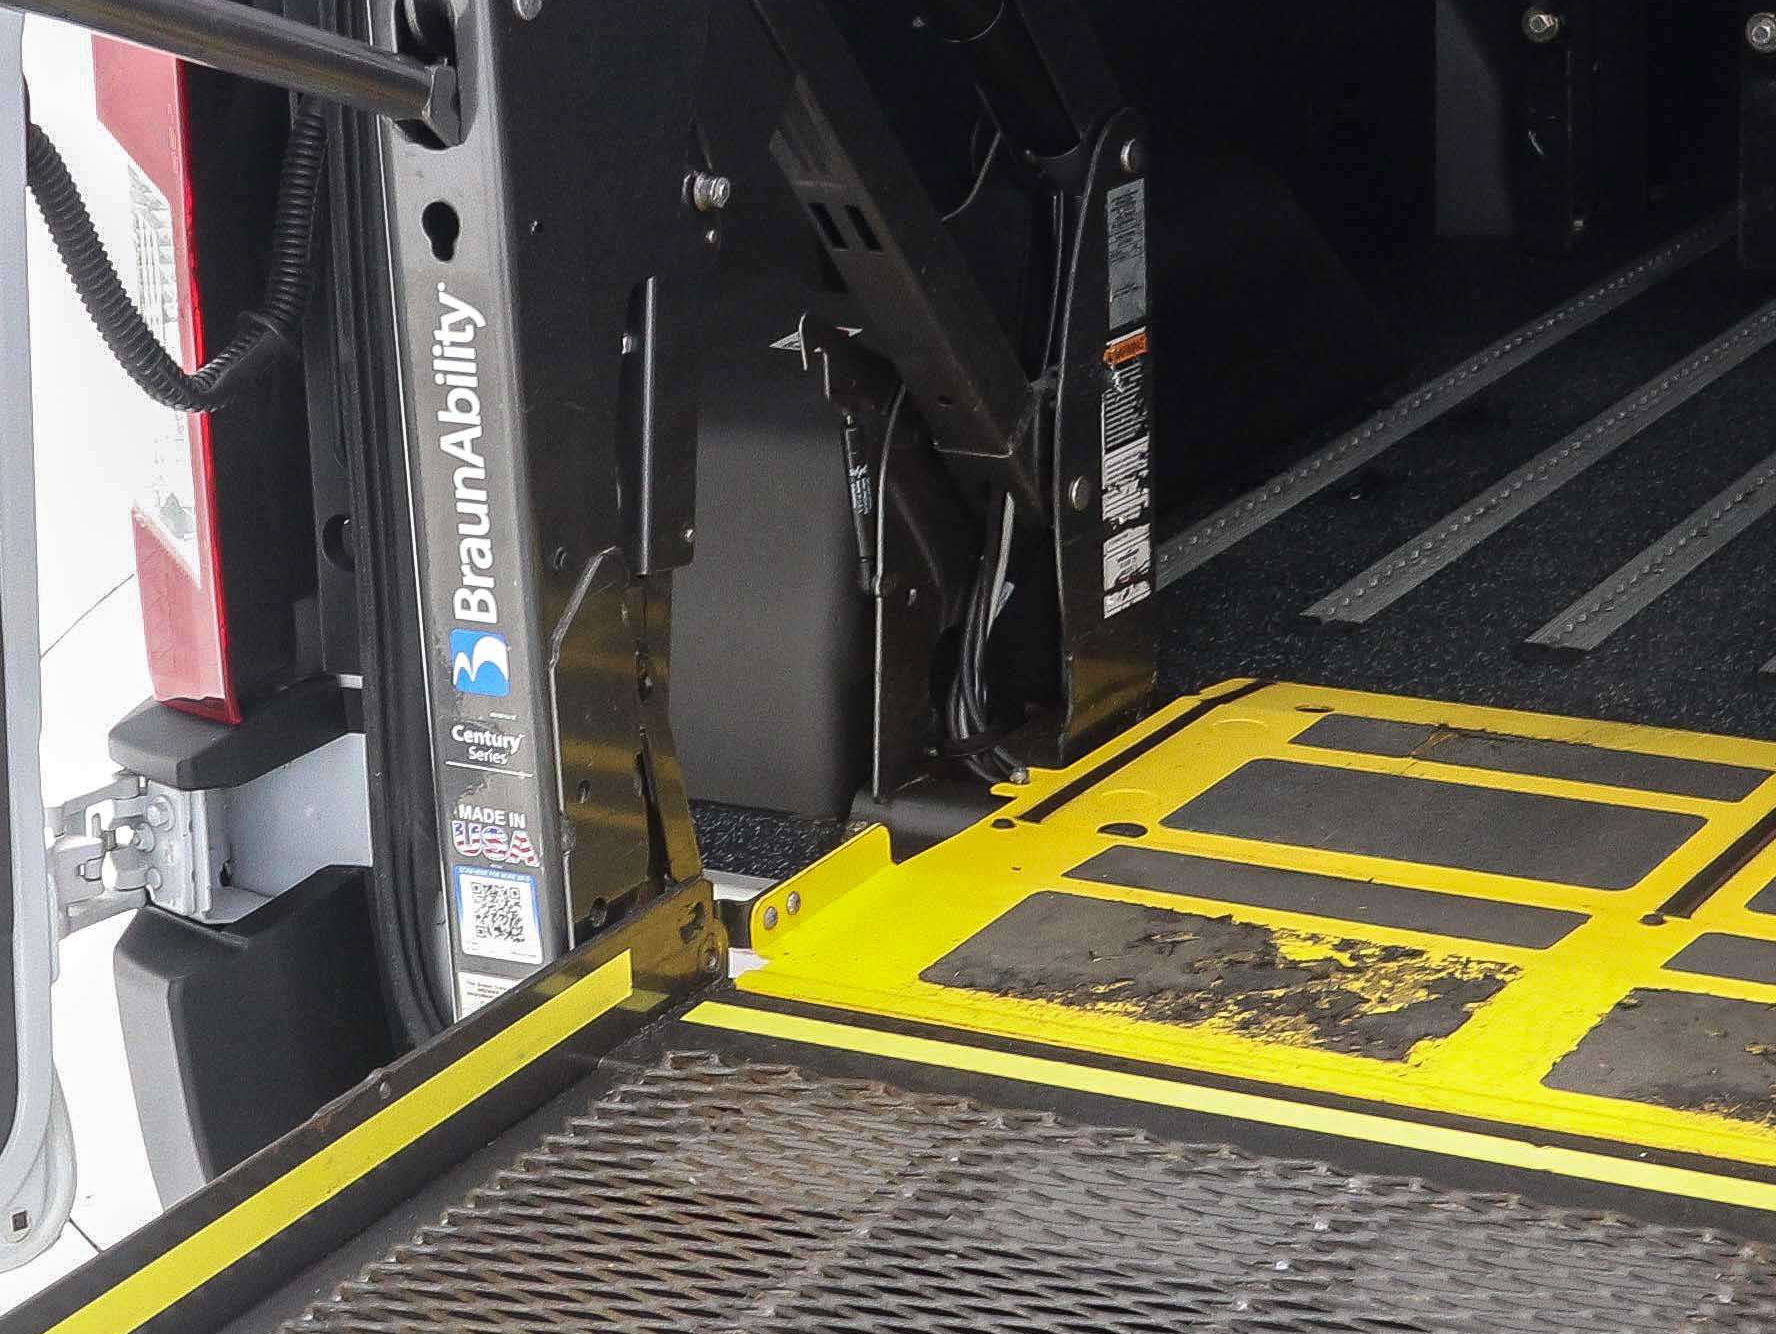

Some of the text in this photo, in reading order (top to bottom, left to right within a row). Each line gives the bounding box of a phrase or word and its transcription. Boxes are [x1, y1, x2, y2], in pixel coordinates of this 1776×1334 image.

[432, 289, 498, 625] BraunAbility
[451, 725, 523, 754] Century
[468, 746, 509, 765] Series
[458, 804, 526, 829] MADE IN
[451, 820, 540, 867] USA
